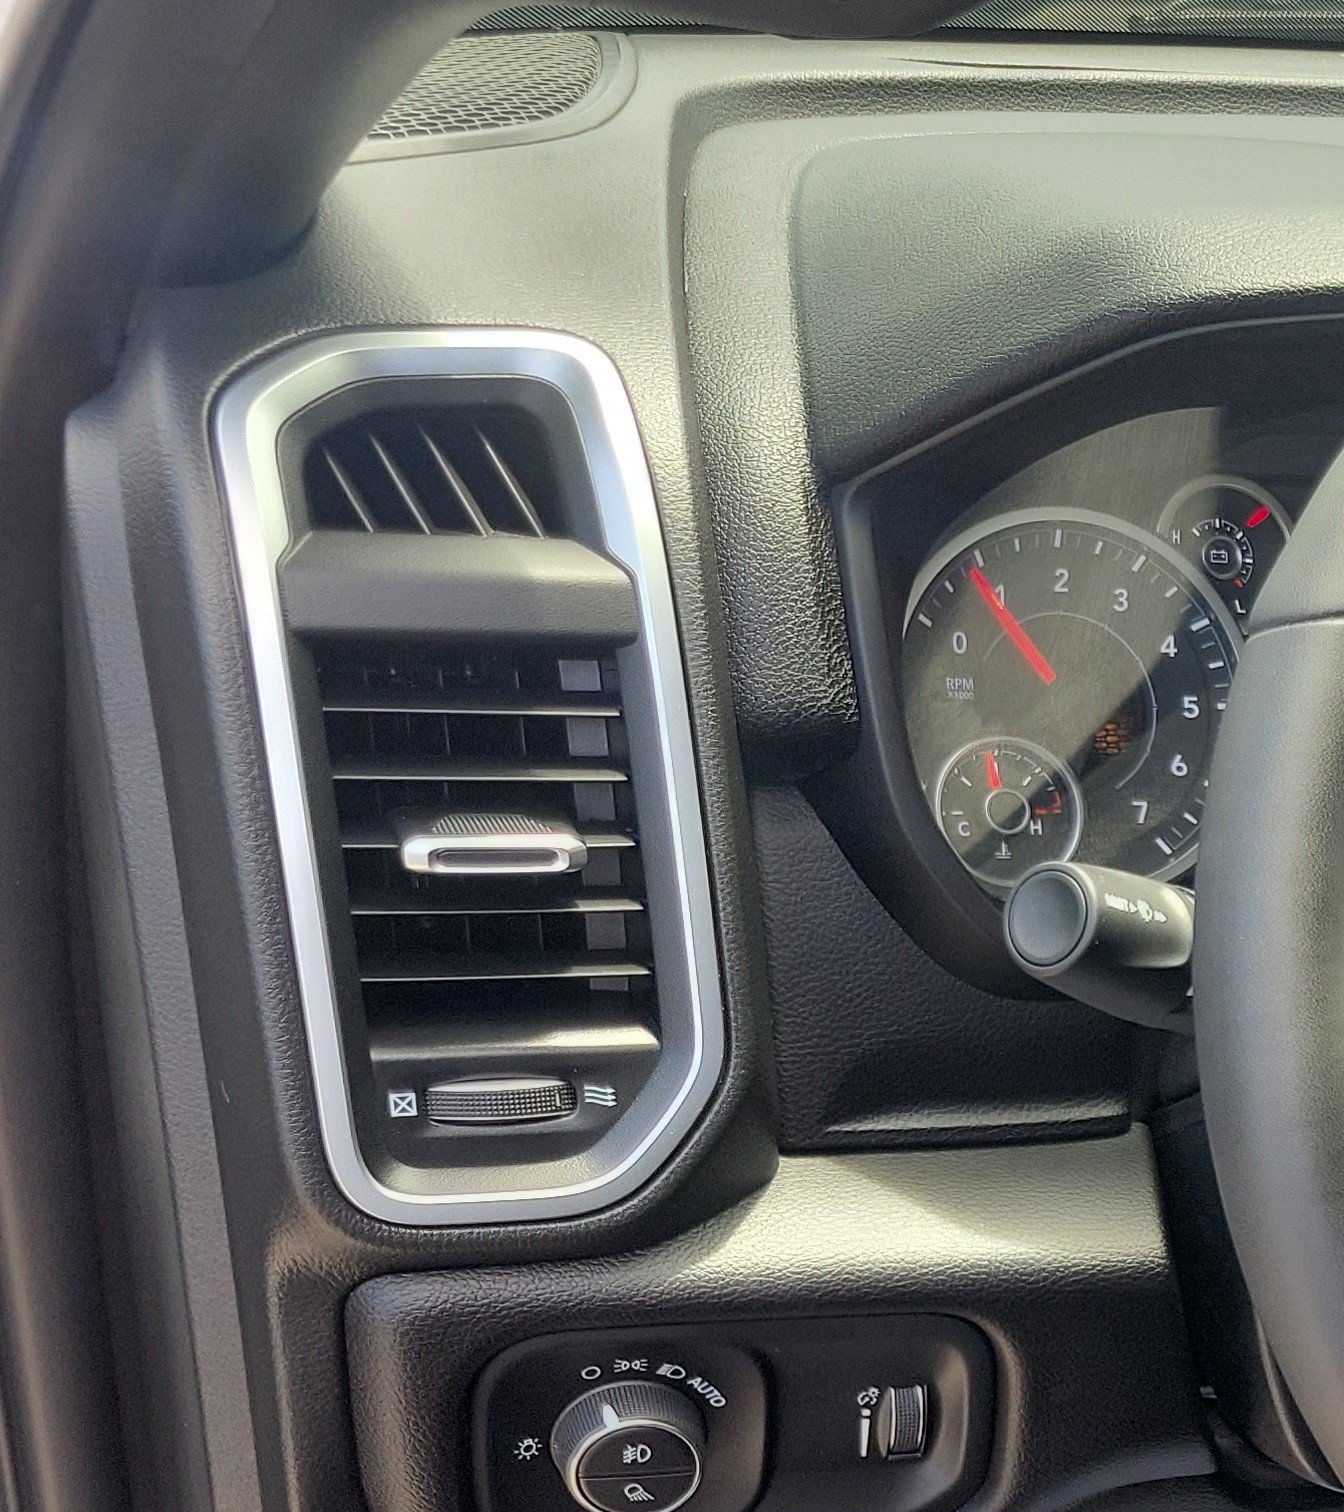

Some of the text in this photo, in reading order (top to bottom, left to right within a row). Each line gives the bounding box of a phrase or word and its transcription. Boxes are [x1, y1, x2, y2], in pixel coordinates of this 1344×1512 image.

[1172, 529, 1181, 544] H
[1054, 568, 1069, 593] 2
[995, 584, 1006, 610] 1
[1113, 588, 1129, 612] 3
[1234, 599, 1246, 613] L
[953, 632, 968, 654] 0
[1160, 634, 1178, 658] 4
[946, 677, 974, 691] RPM
[1182, 696, 1200, 719] 5
[1171, 753, 1188, 777] 6
[1132, 801, 1148, 824] 7
[958, 821, 971, 836] C
[1030, 819, 1043, 836] H
[686, 1376, 727, 1408] AUTO
